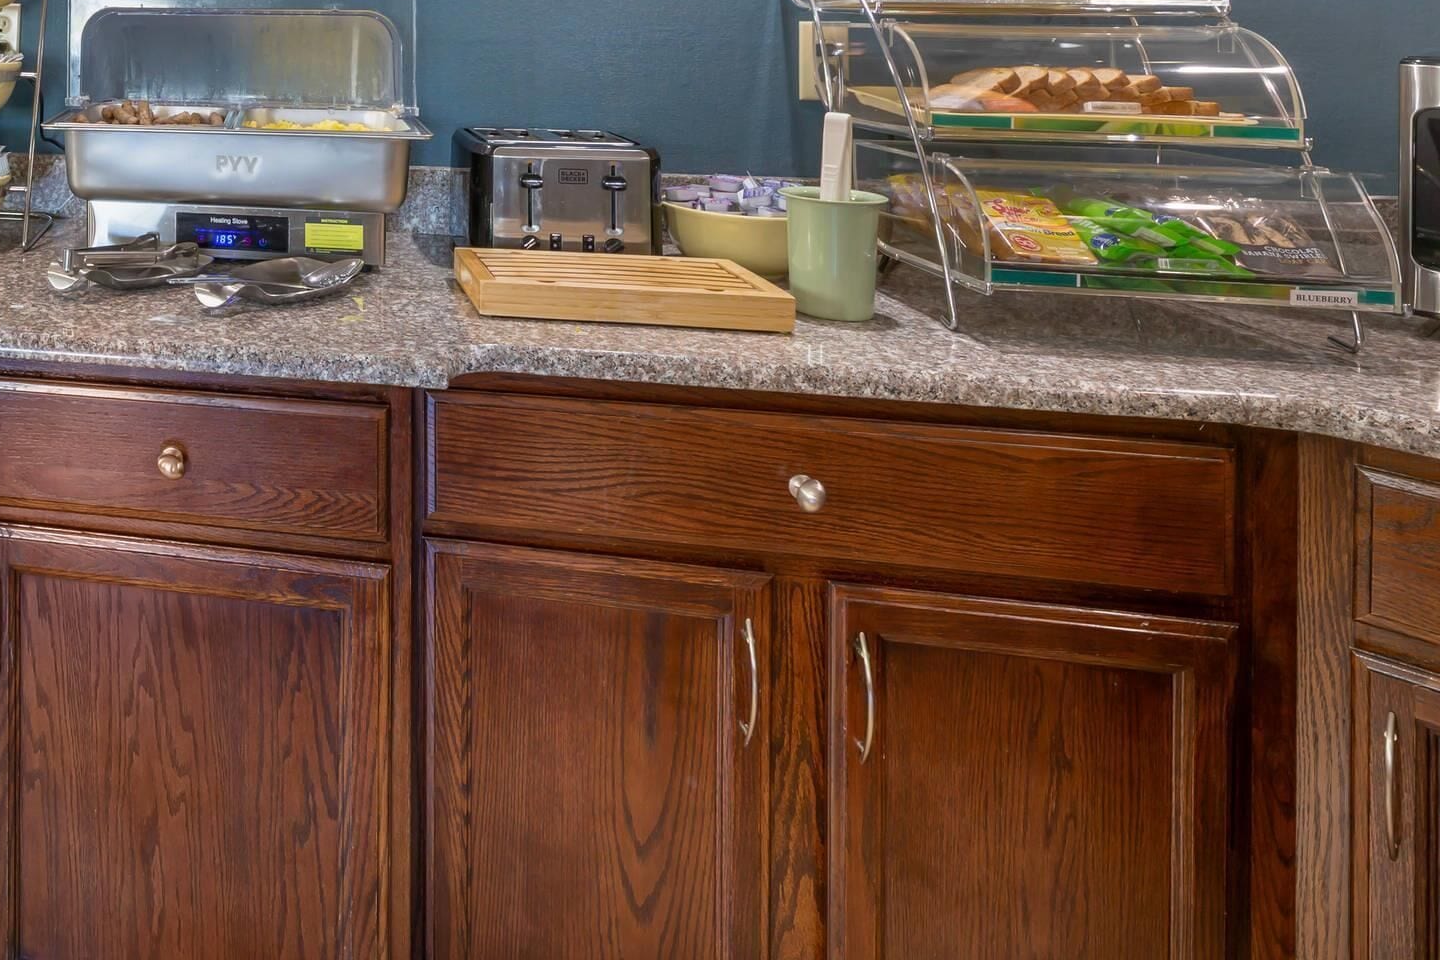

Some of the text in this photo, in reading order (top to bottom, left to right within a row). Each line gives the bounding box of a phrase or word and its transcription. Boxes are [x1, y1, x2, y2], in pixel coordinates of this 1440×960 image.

[210, 216, 249, 225] Heating Stove
[1043, 228, 1076, 237] Bread
[1295, 294, 1353, 304] BLUEBERRY
